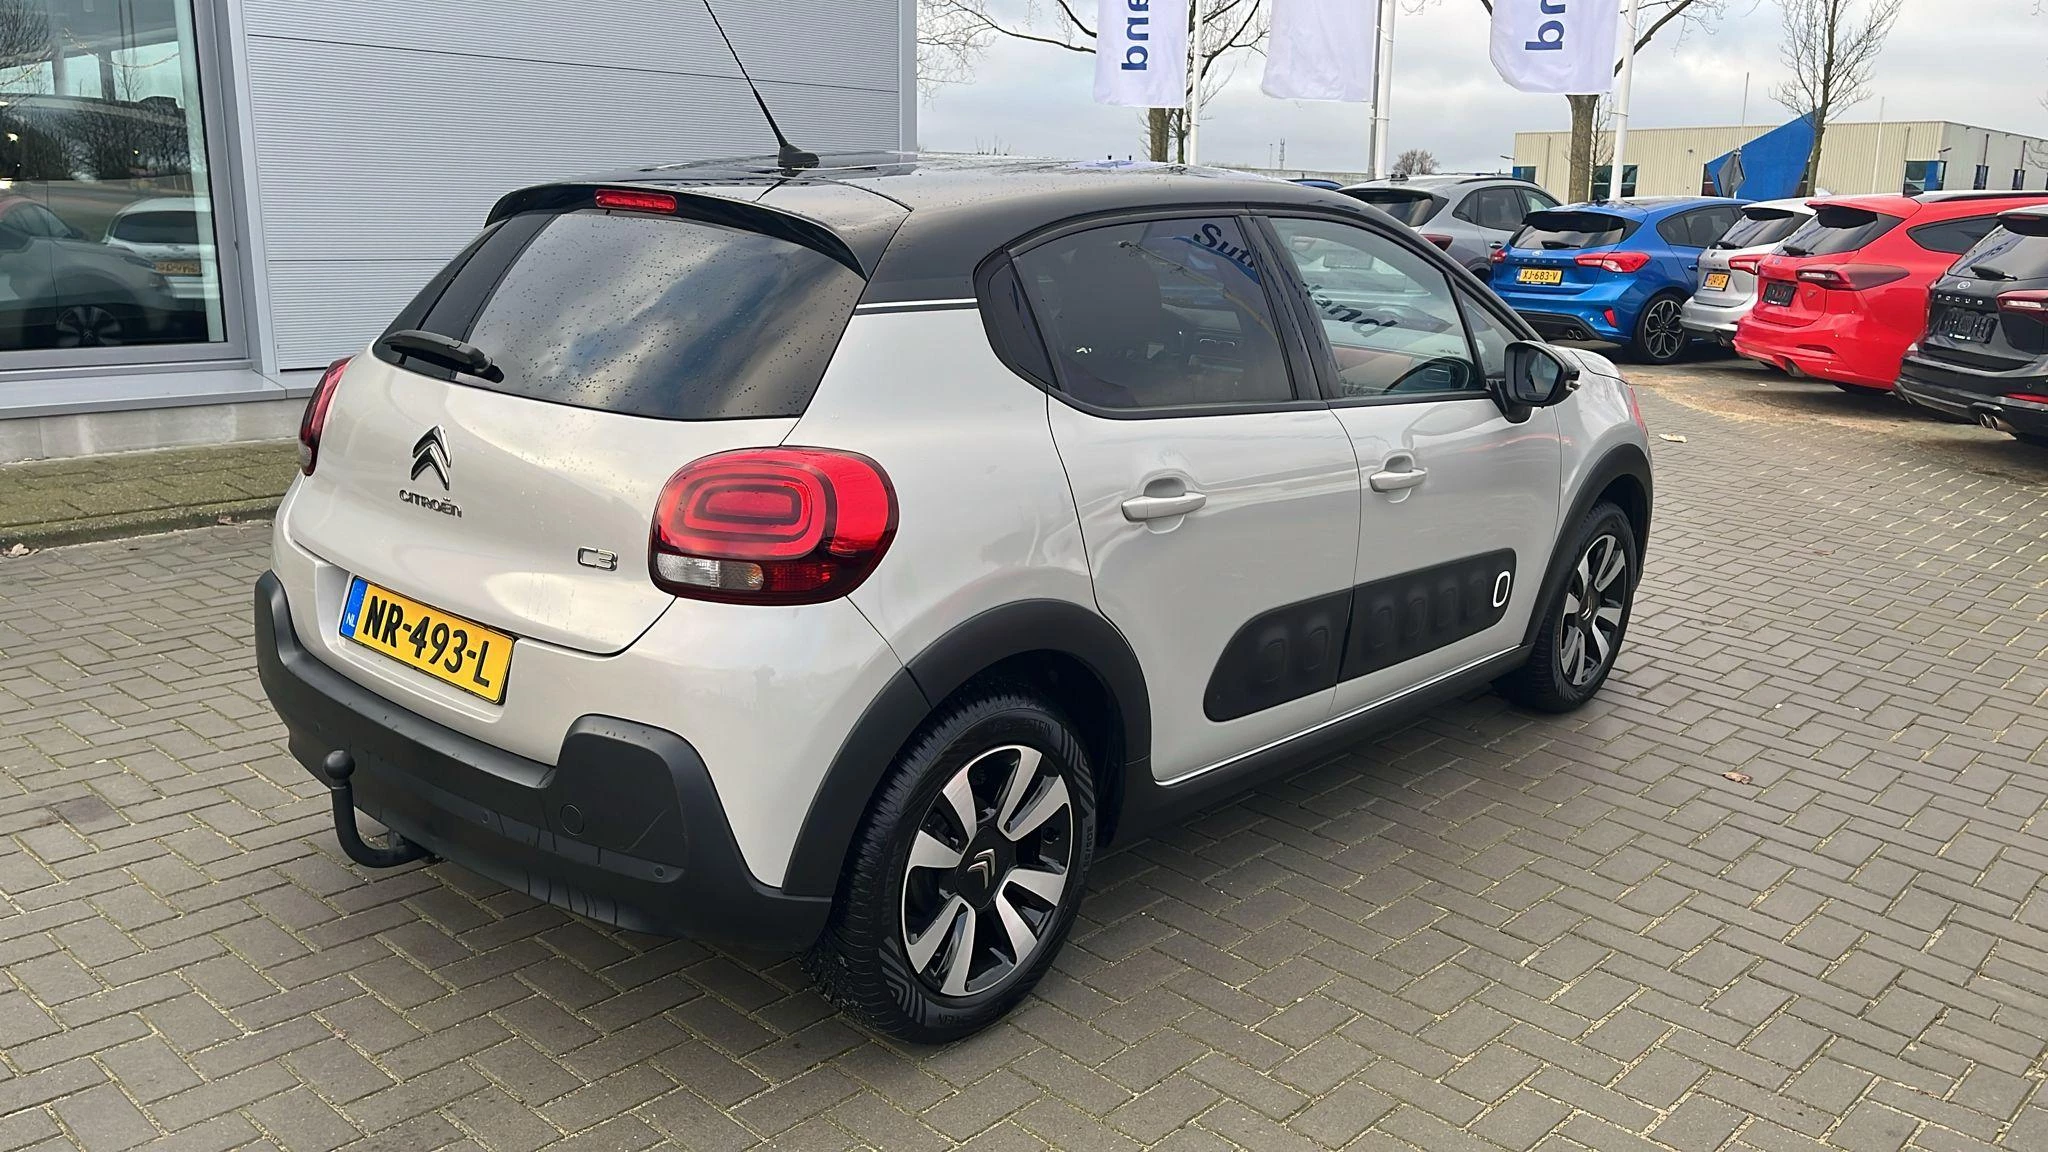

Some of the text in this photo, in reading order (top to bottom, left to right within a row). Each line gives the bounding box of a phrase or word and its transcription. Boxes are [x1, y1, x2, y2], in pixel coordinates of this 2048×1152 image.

[1522, 271, 1559, 281] XJ-683-V
[577, 545, 618, 571] C3
[345, 612, 356, 628] NL
[363, 595, 491, 688] NR-493-L
